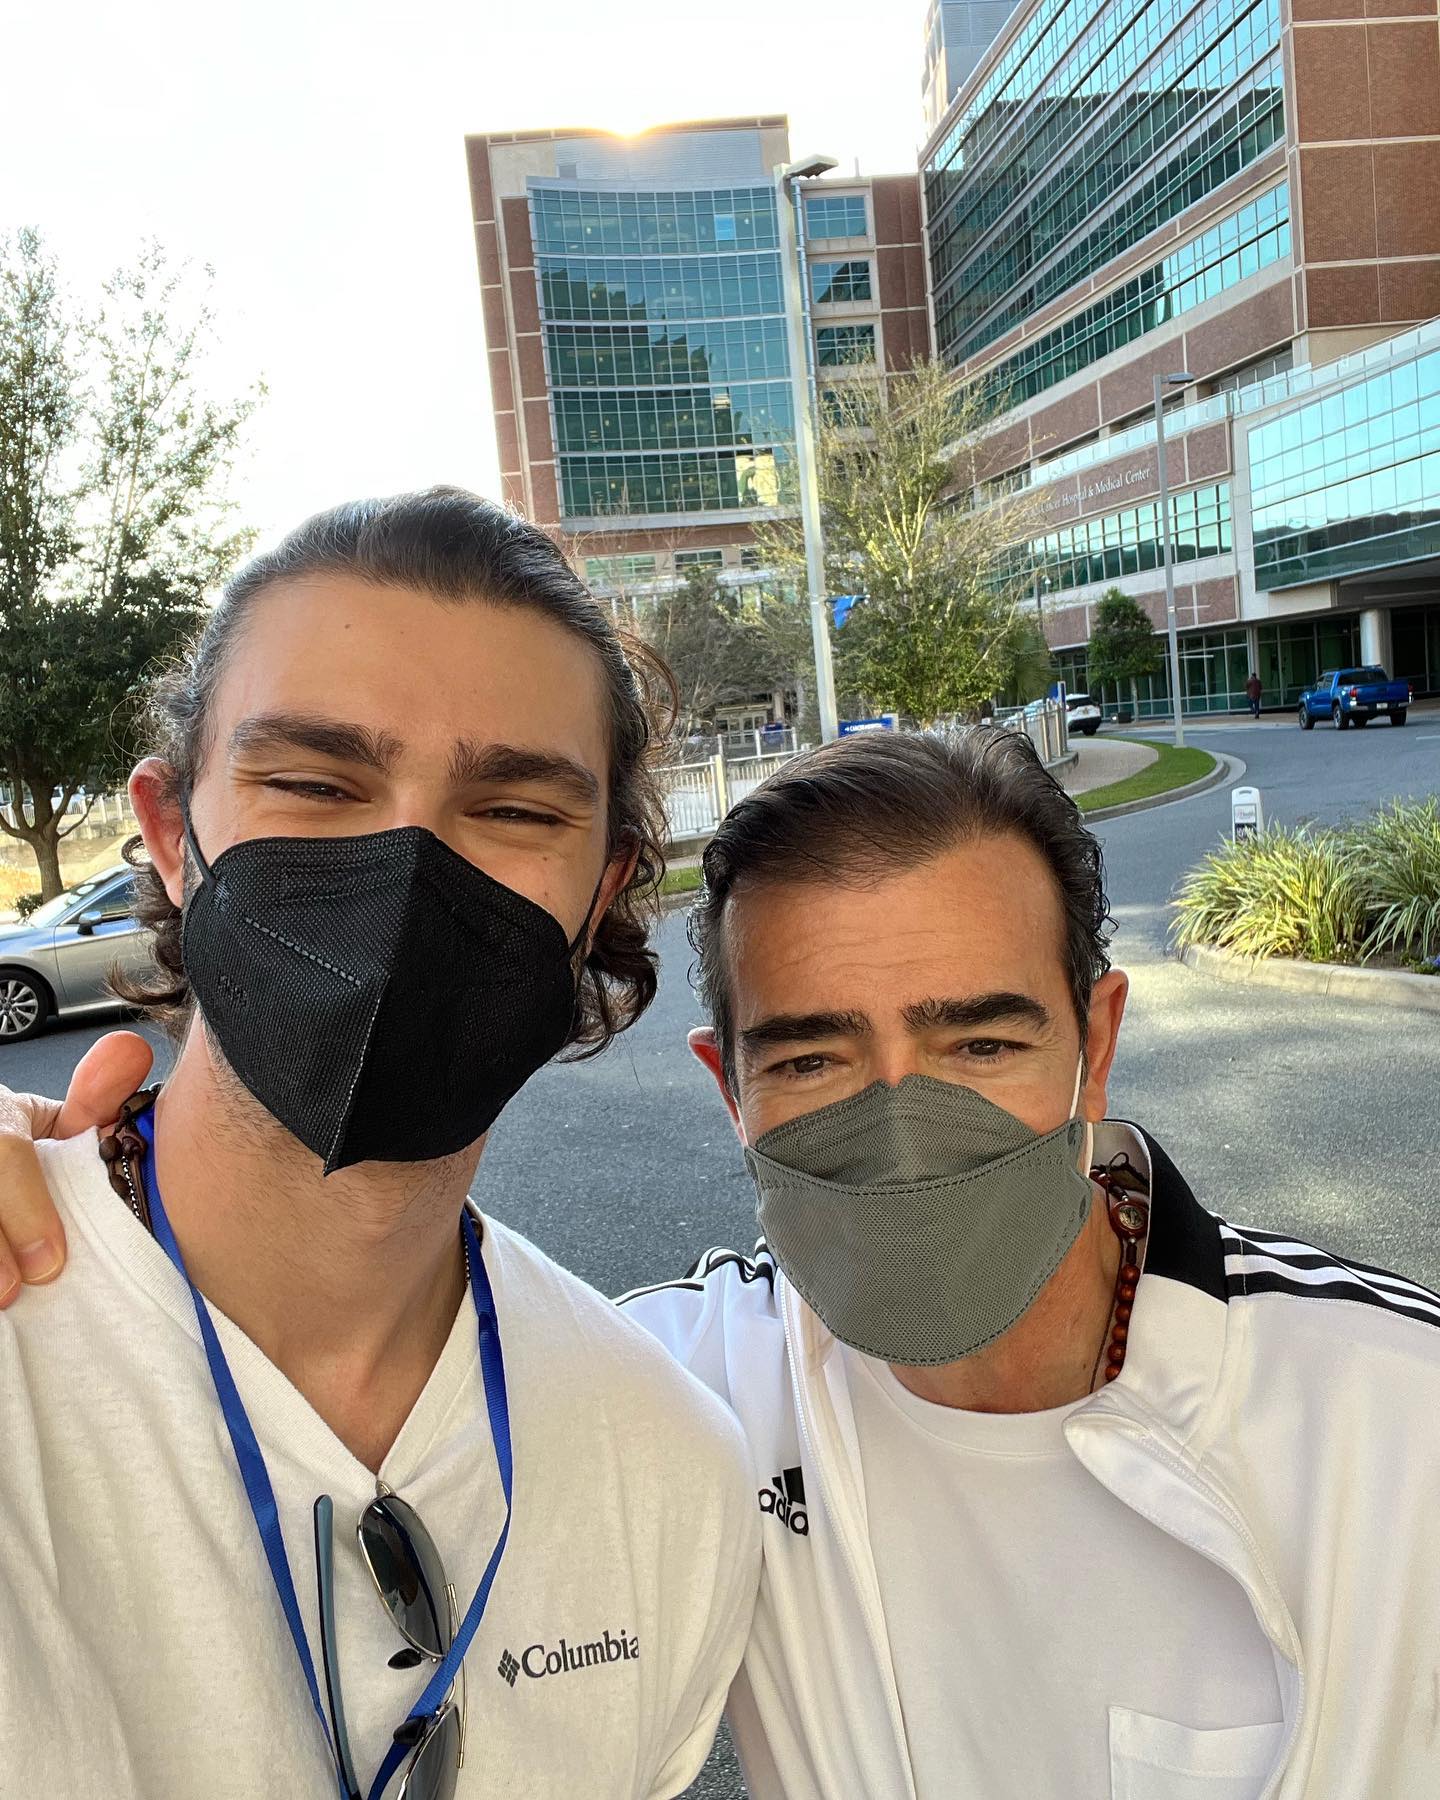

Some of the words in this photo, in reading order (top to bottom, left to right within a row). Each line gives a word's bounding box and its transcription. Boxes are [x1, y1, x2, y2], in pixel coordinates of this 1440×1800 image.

[1088, 487, 1094, 497] &
[1095, 474, 1123, 495] Medical
[1125, 468, 1150, 484] Center
[521, 1629, 639, 1678] Columbia
